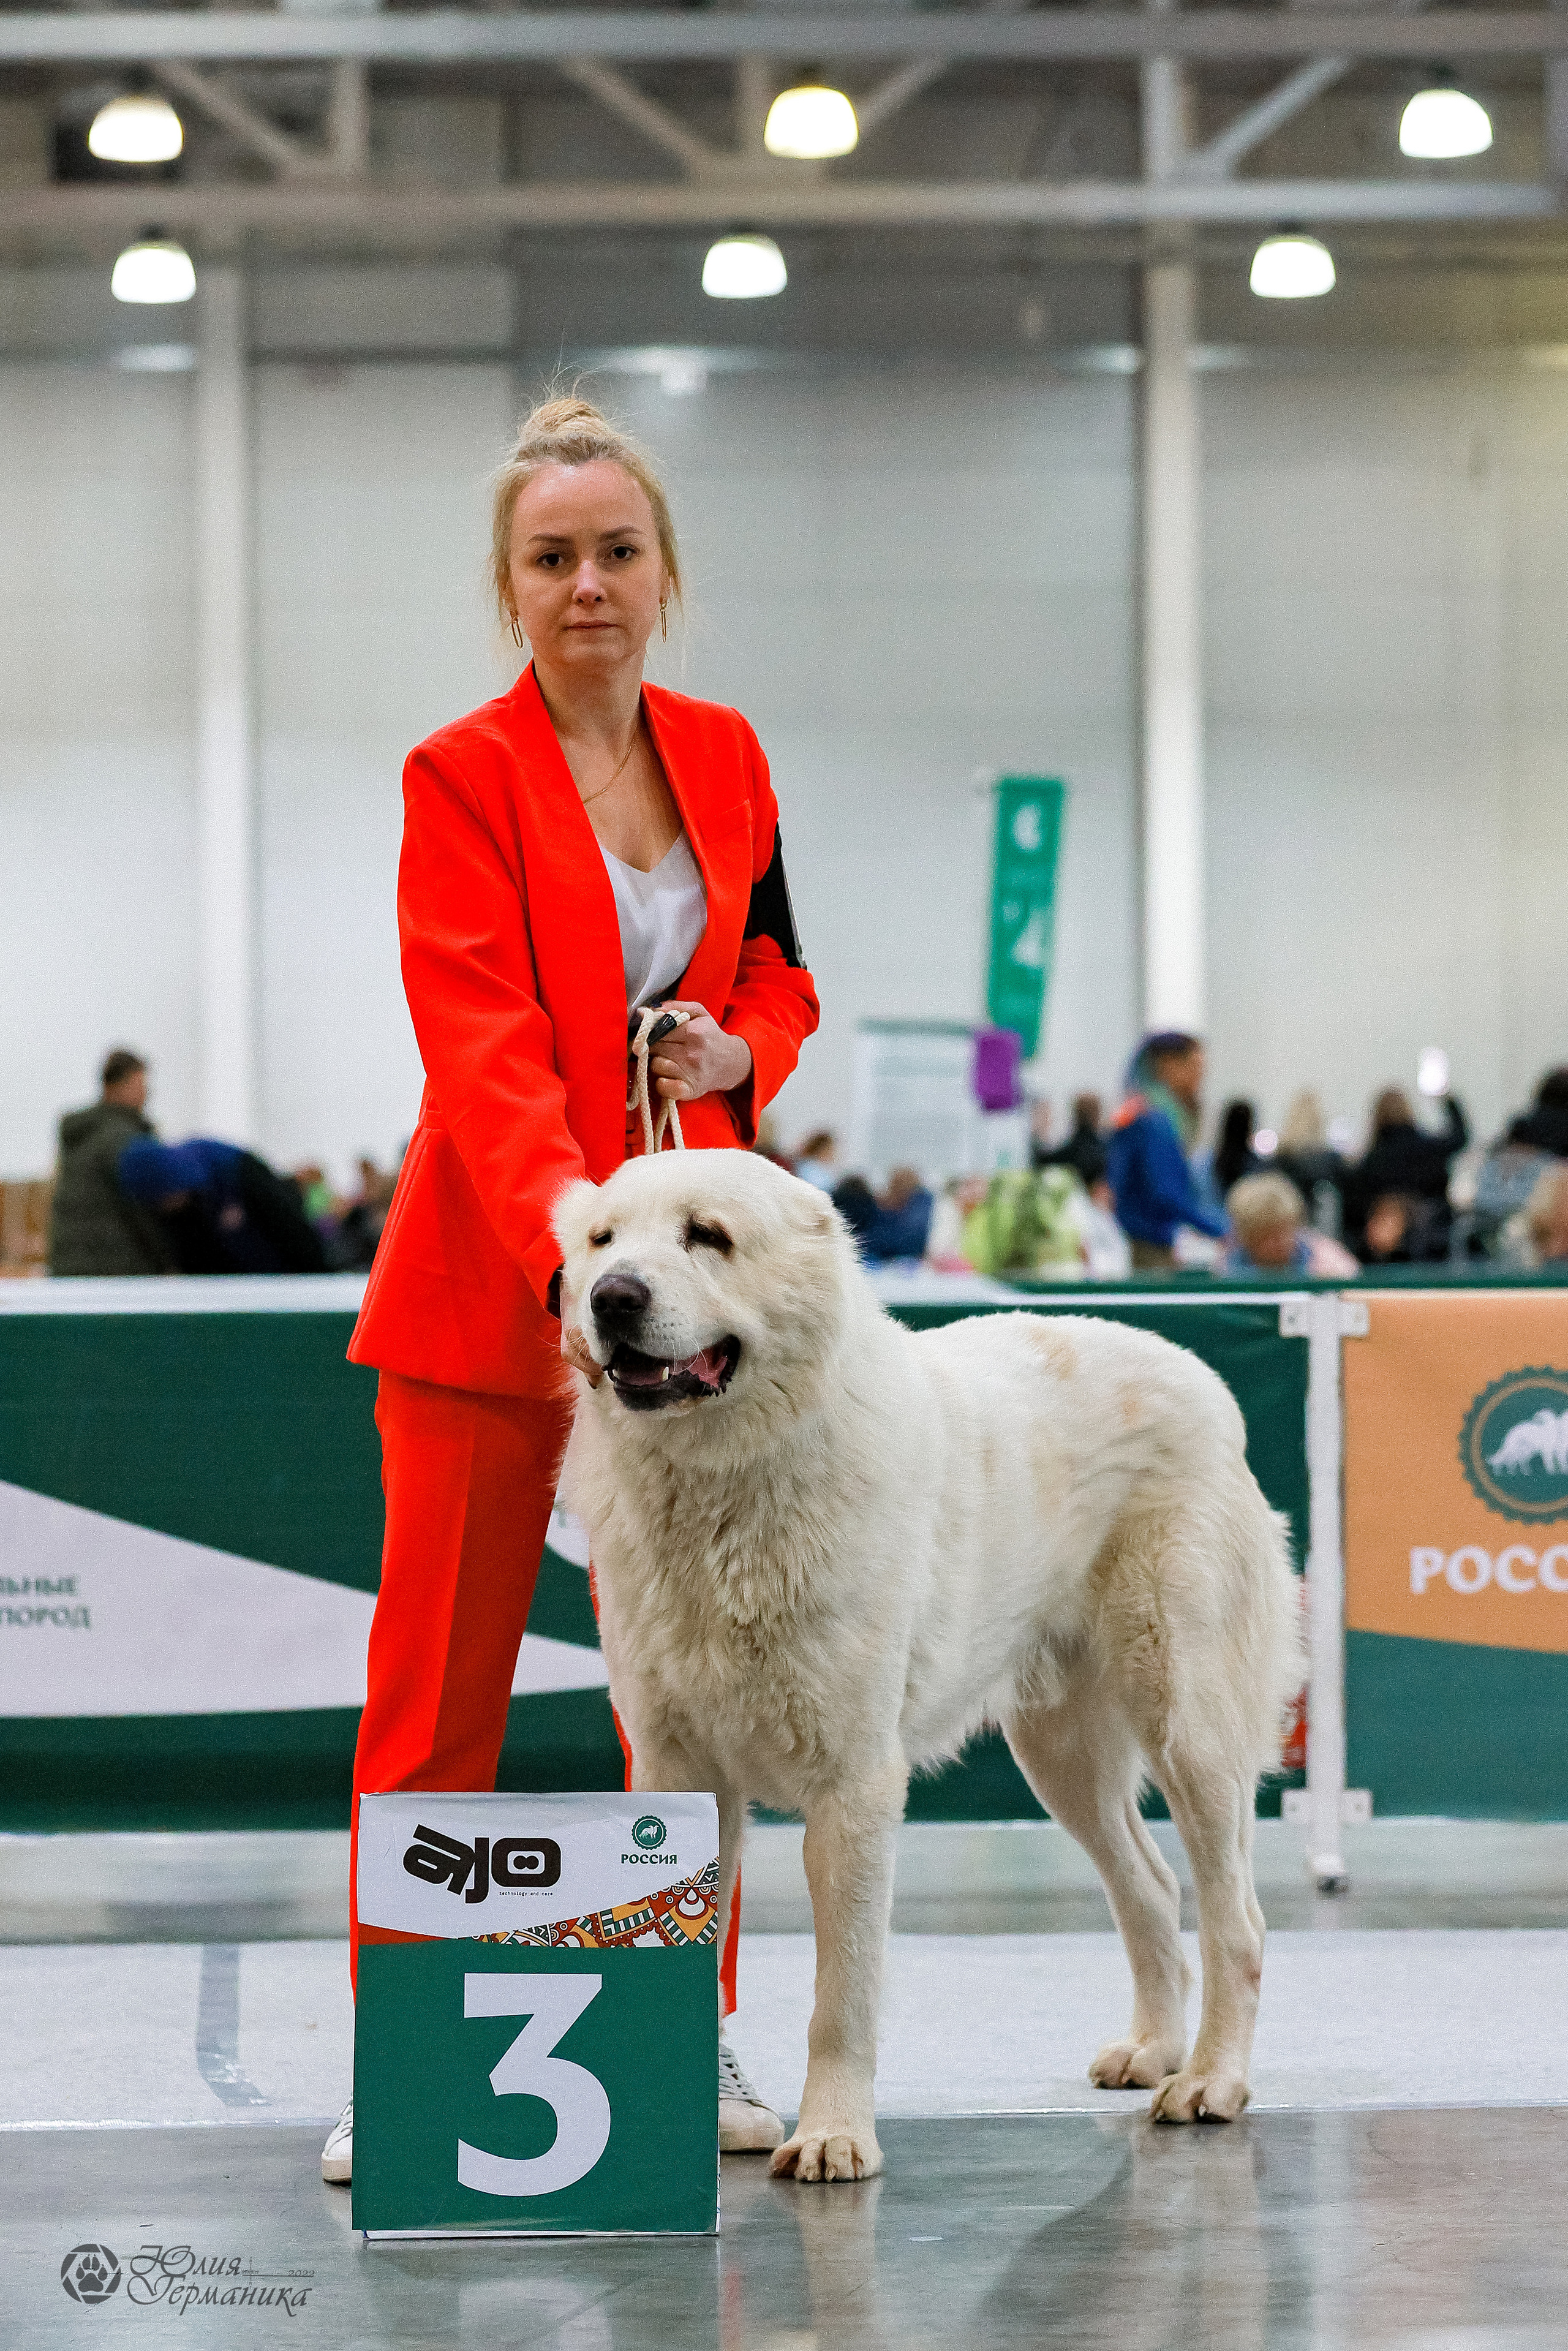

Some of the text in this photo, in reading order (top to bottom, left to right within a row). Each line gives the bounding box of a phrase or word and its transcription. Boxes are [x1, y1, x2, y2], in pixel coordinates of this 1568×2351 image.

[1411, 1545, 1568, 1594] РОСС
[621, 1854, 677, 1864] РОССИЯ
[458, 1972, 611, 2197] 3
